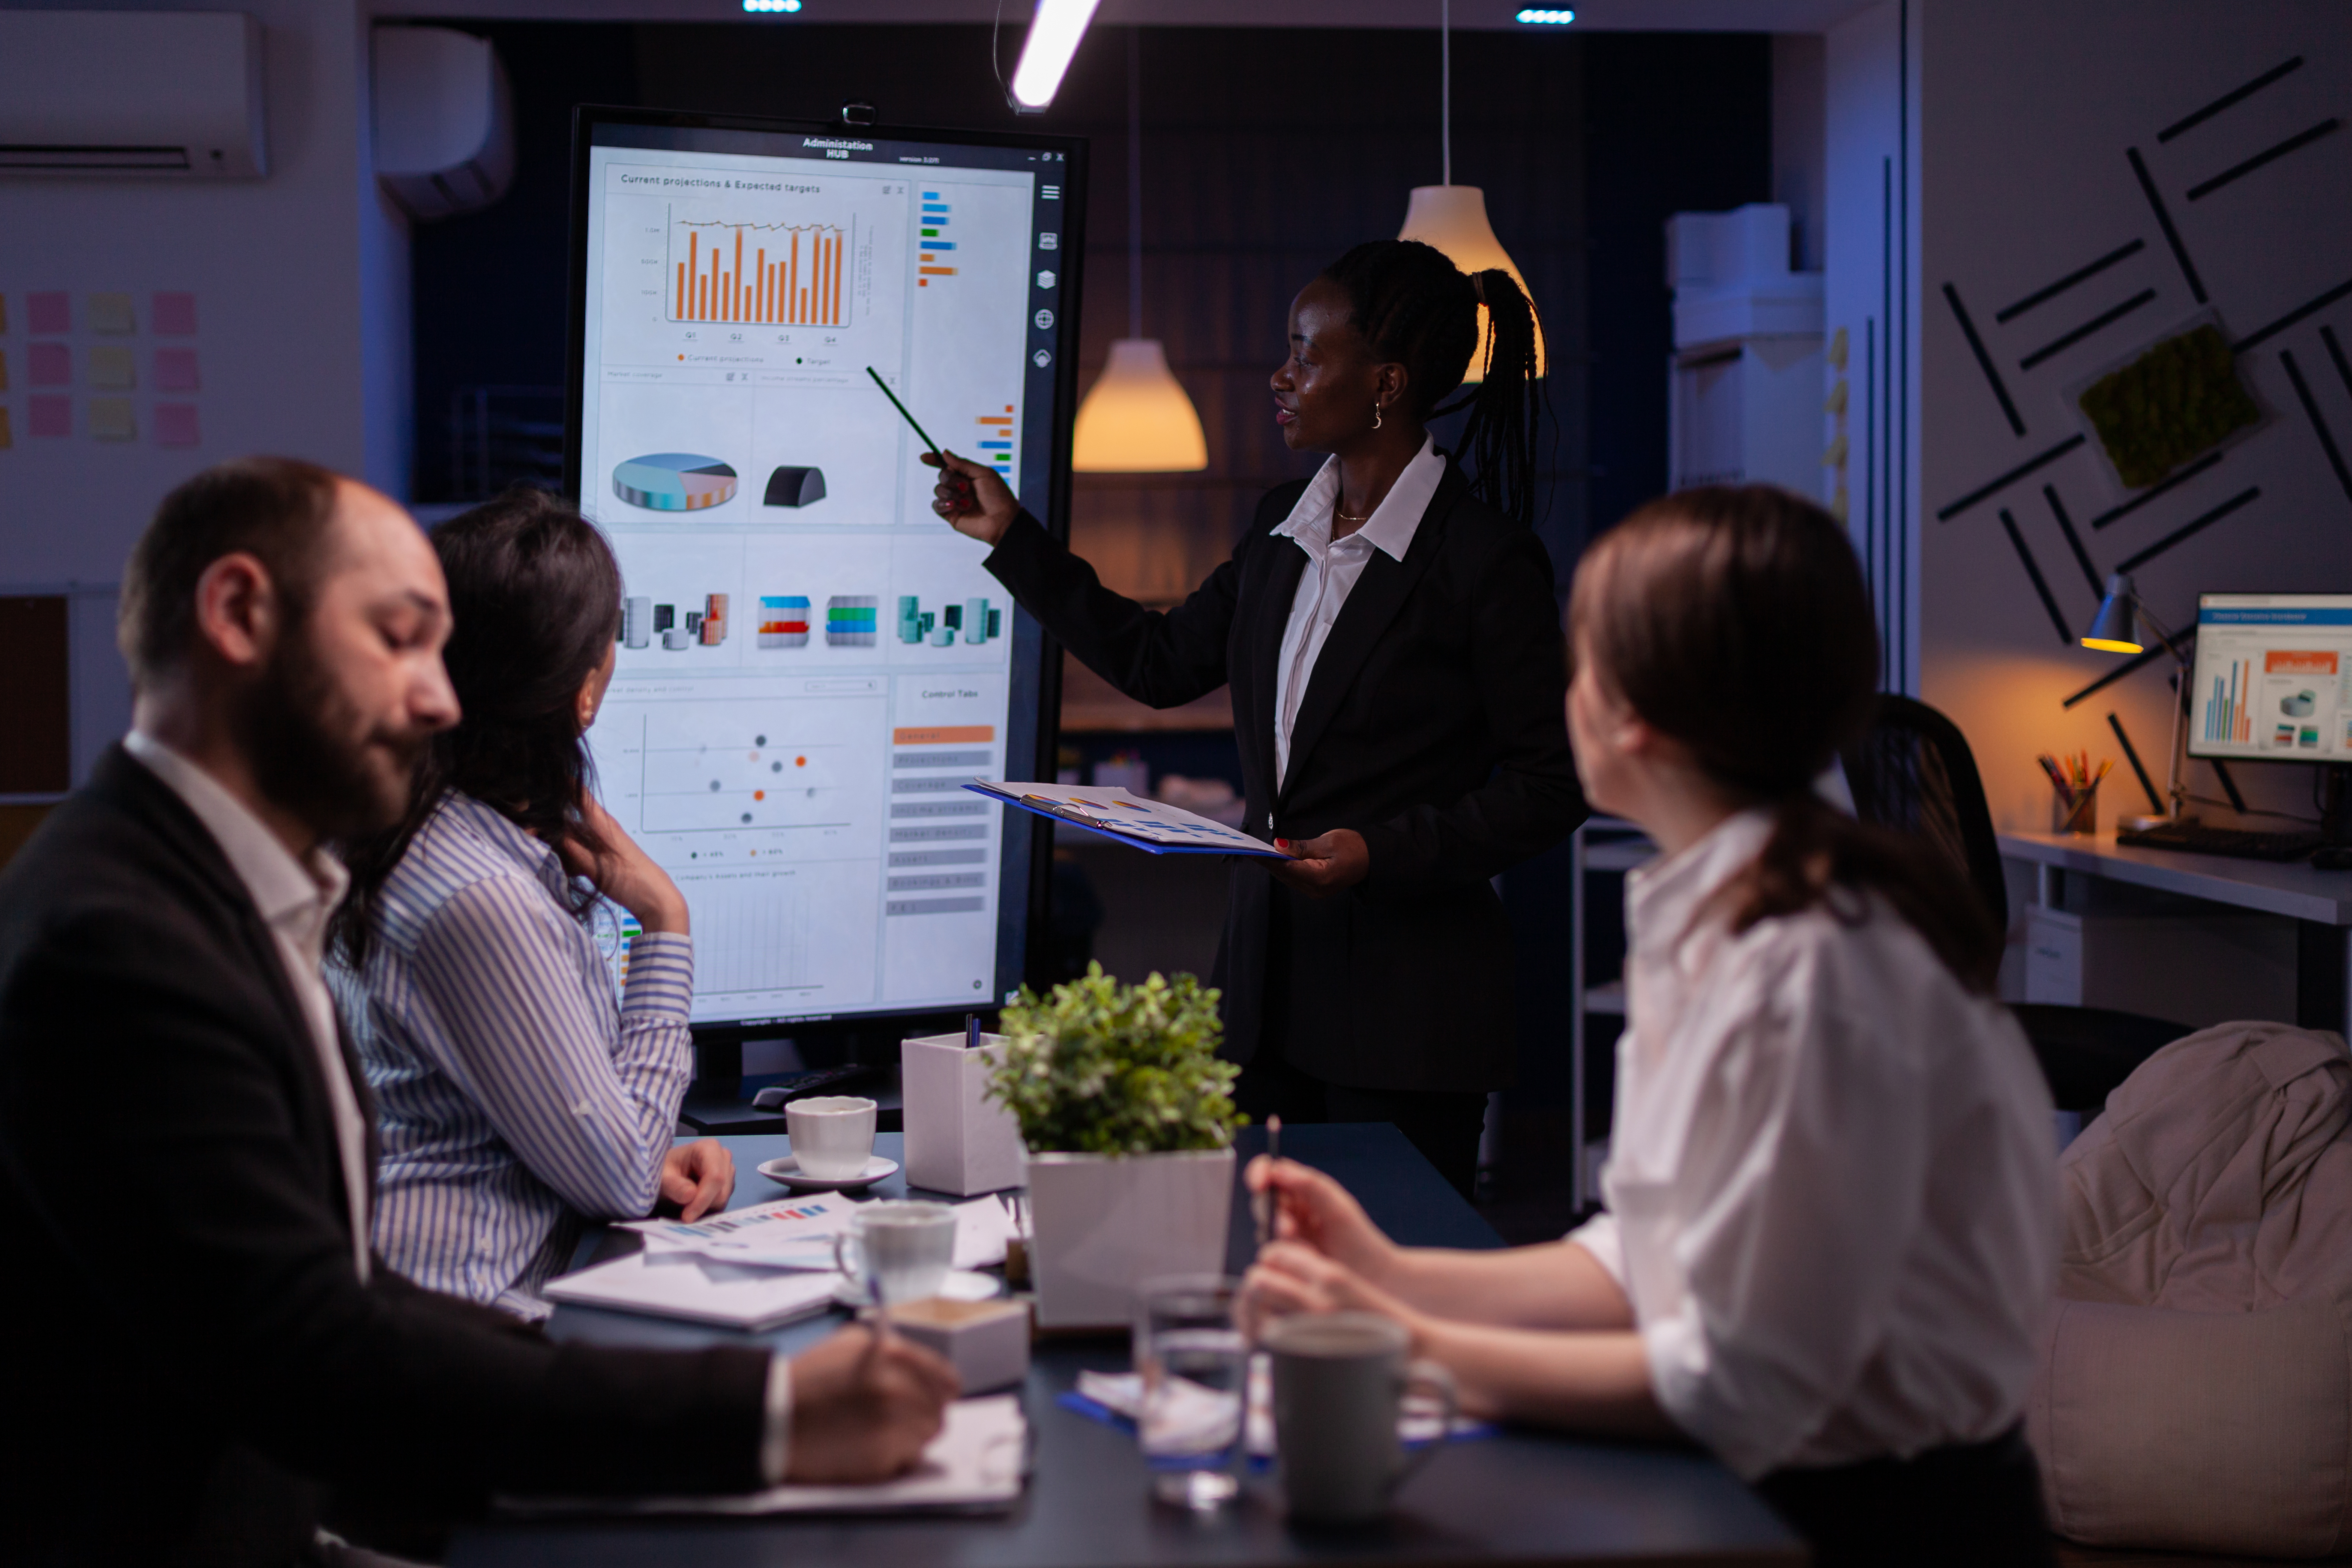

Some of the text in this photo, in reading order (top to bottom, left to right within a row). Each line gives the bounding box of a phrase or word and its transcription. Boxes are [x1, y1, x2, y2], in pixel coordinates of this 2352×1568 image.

[802, 138, 874, 151] Administation
[827, 149, 849, 159] HUB
[620, 174, 821, 194] Current projections & Expected targets
[687, 354, 718, 363] Current
[807, 357, 831, 366] Target
[922, 690, 978, 699] Control Tabs
[899, 732, 940, 740] General
